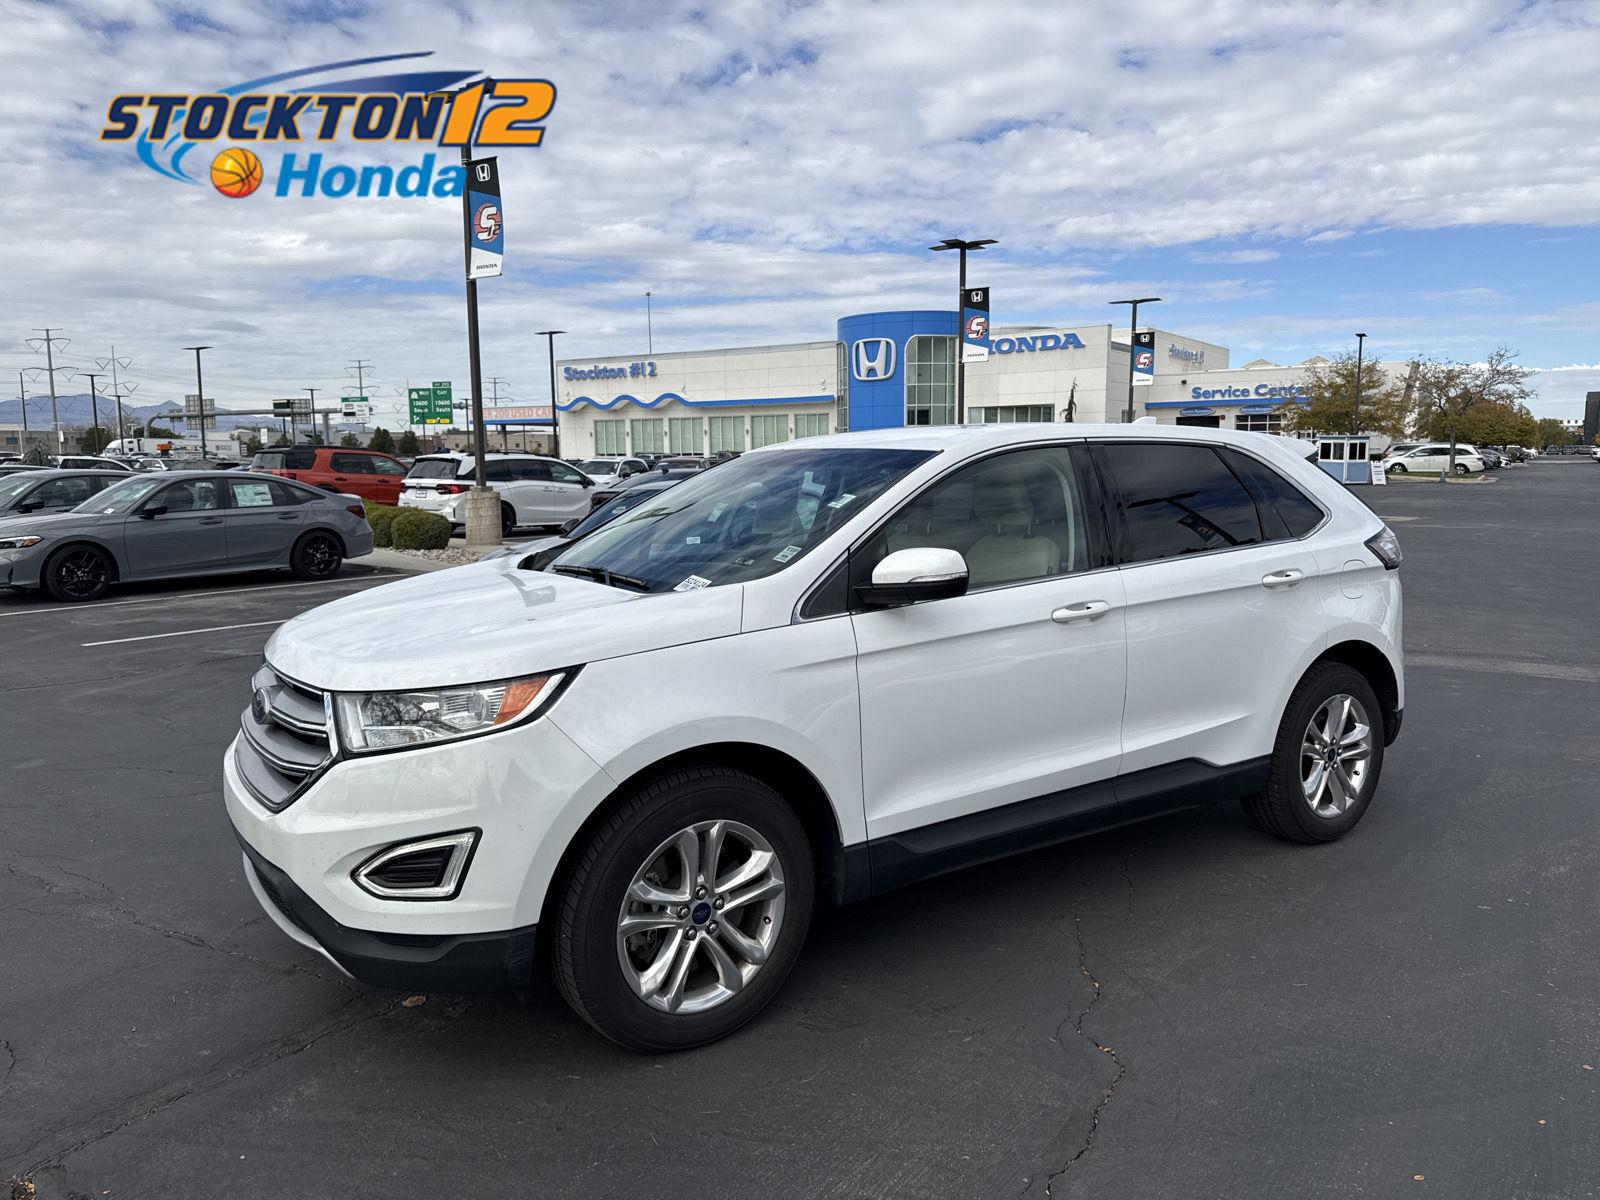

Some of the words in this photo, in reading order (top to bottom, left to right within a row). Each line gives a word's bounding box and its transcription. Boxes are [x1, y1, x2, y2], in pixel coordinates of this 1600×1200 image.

[563, 365, 627, 381] Stockton
[629, 361, 657, 378] #12
[1191, 385, 1250, 399] Service
[495, 408, 510, 418] 200
[511, 407, 534, 418] USED
